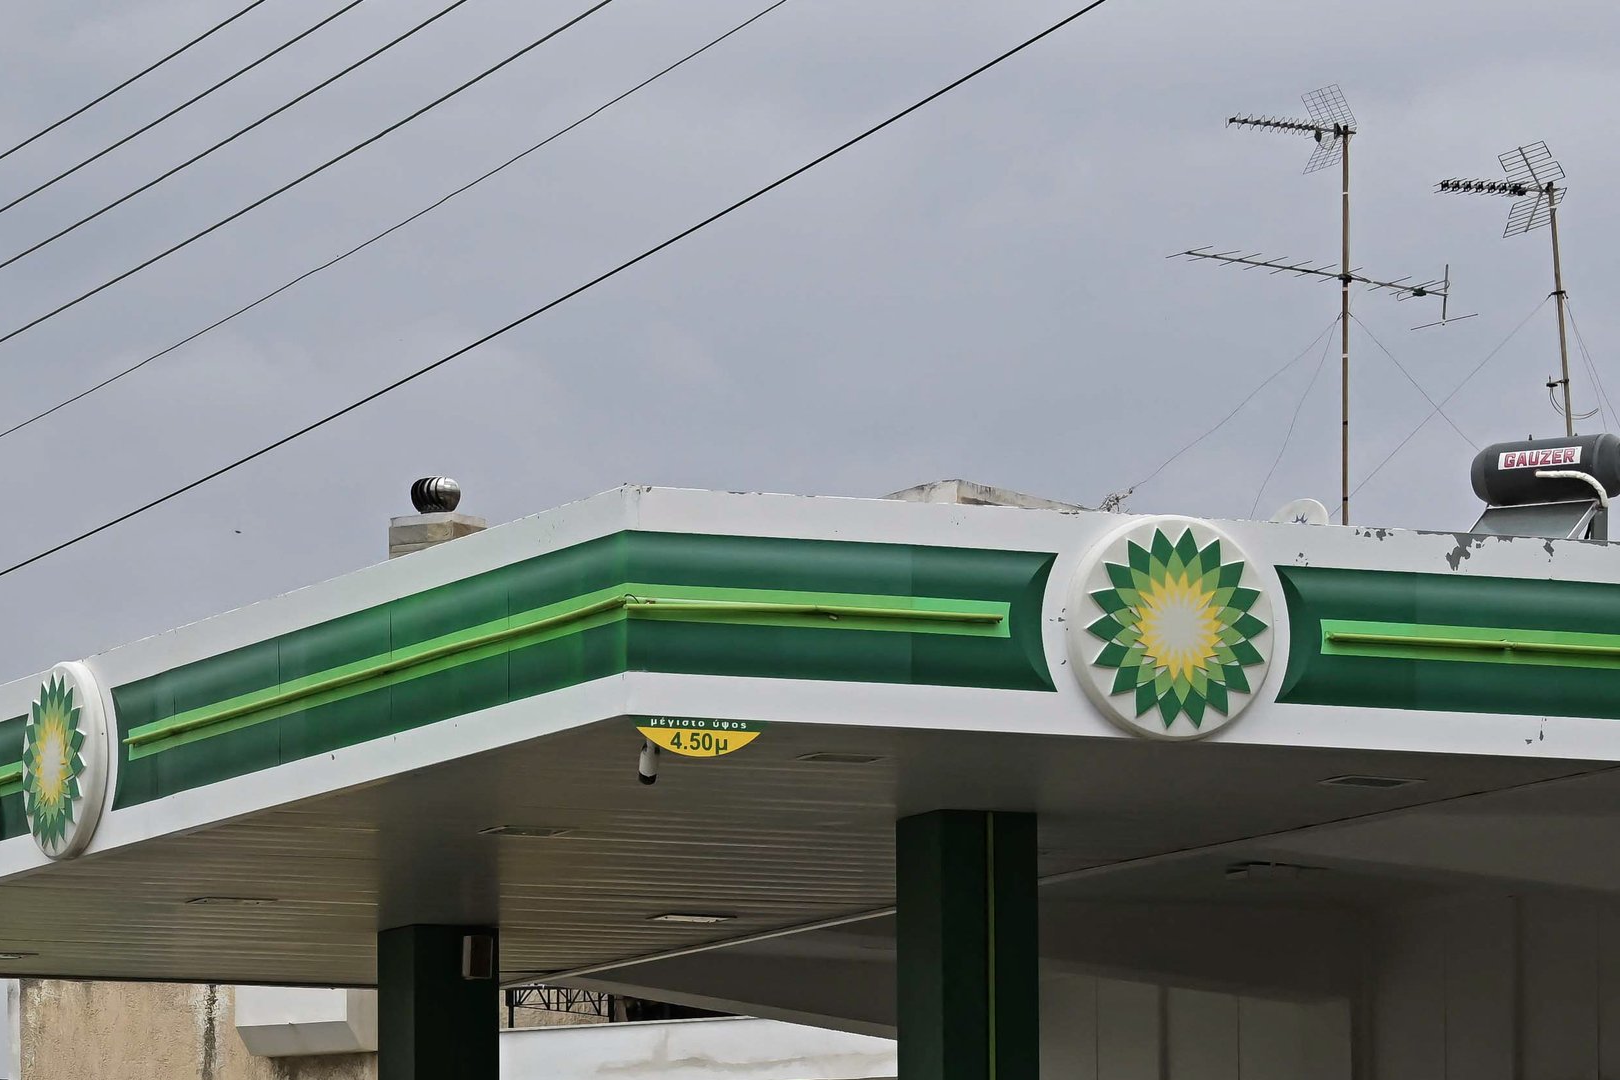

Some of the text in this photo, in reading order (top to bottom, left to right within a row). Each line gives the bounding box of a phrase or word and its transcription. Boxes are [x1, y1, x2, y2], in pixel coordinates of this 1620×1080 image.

[1504, 448, 1576, 468] GAUZER
[650, 716, 747, 730] μέγιστο ύψος
